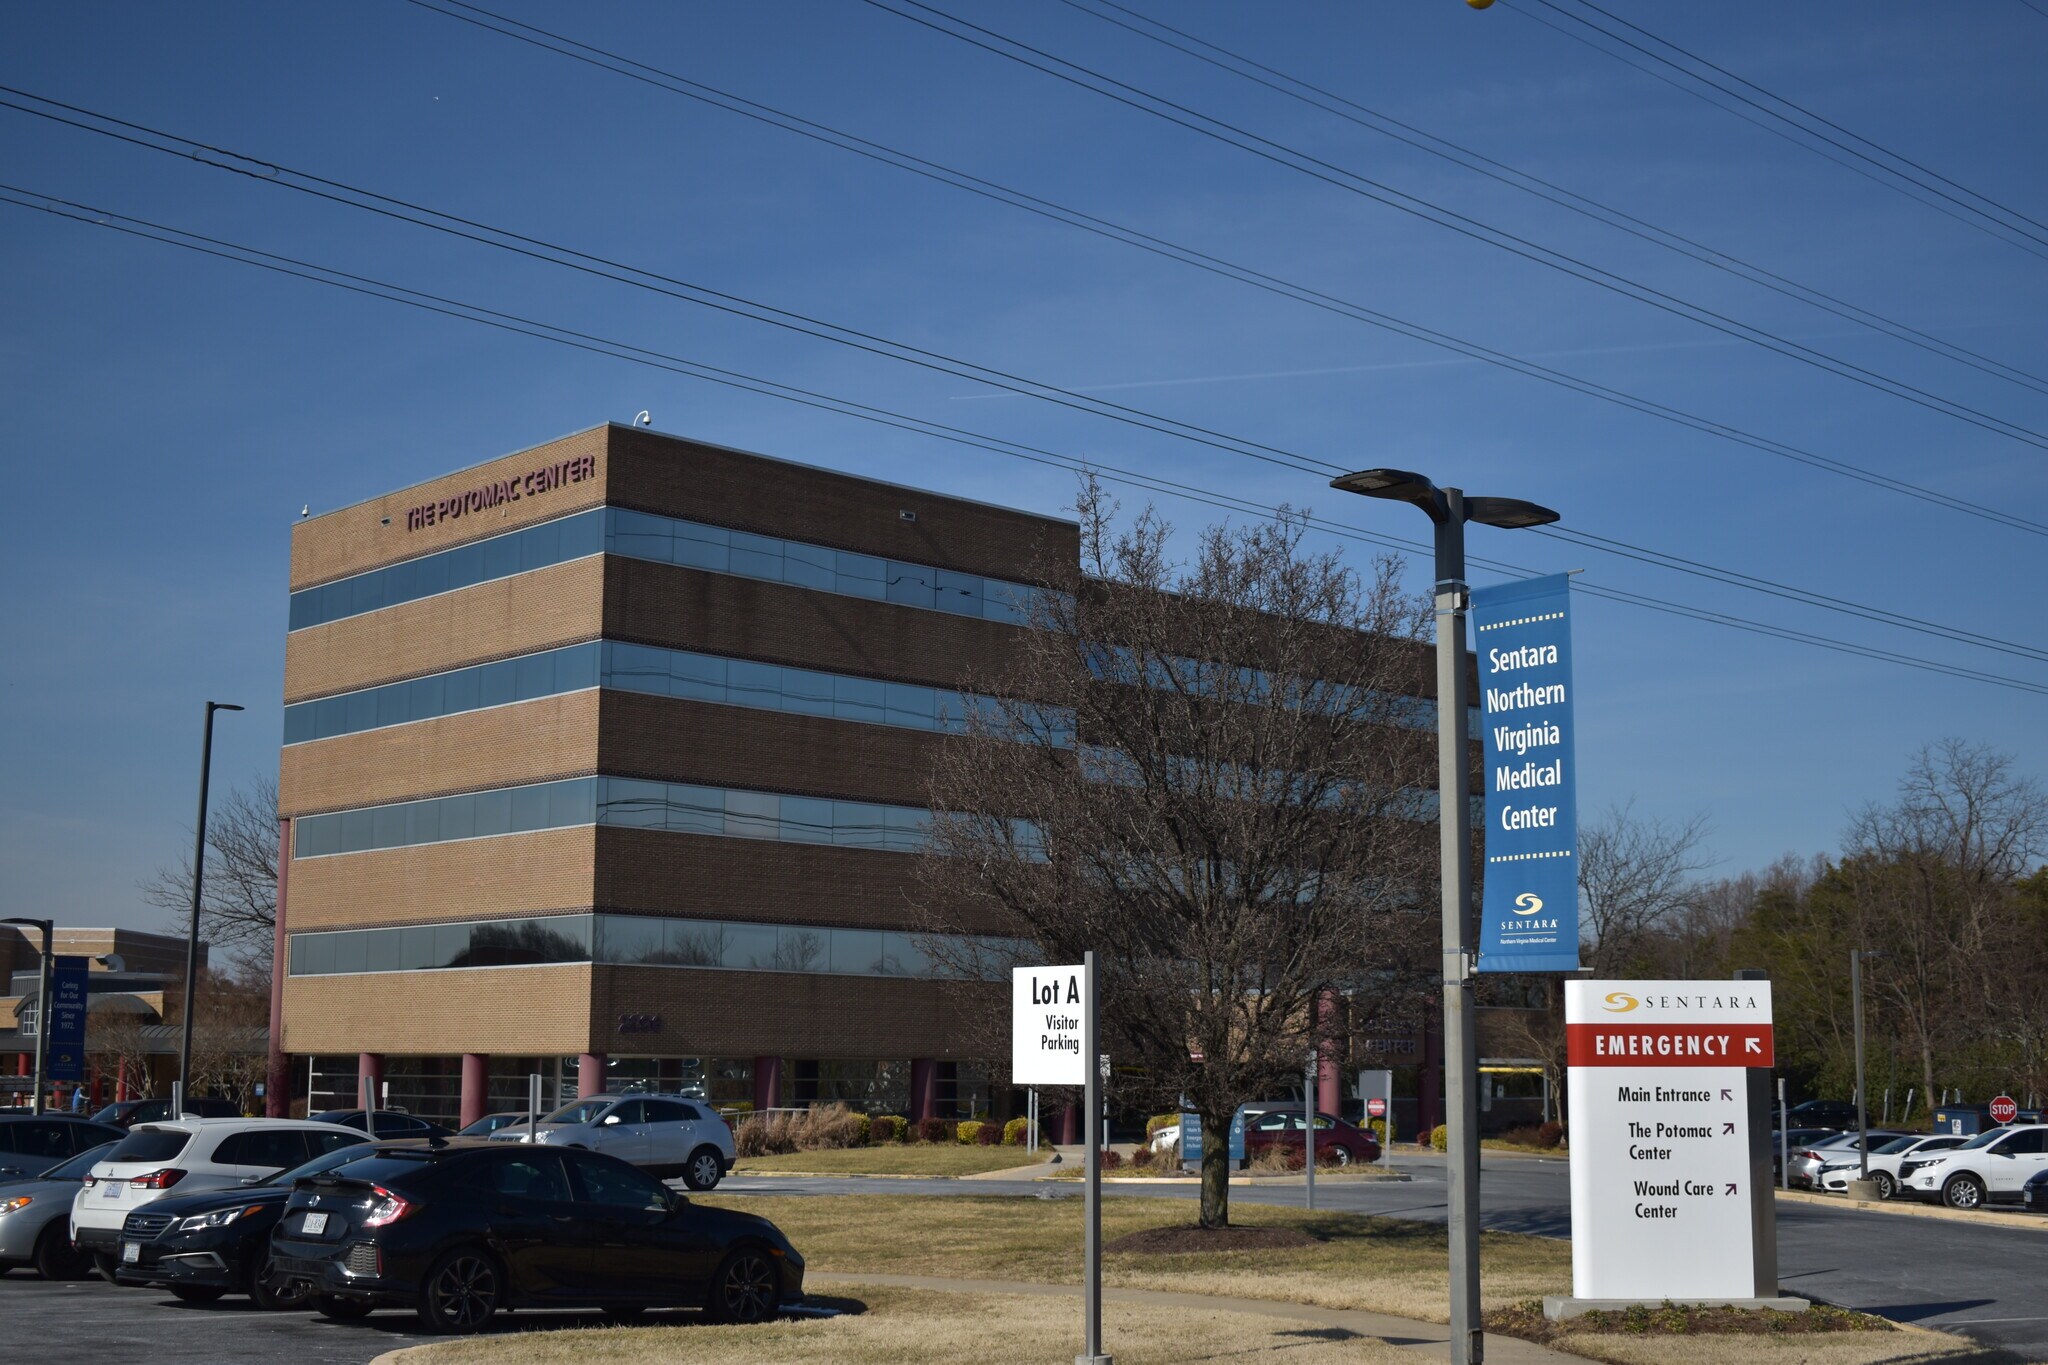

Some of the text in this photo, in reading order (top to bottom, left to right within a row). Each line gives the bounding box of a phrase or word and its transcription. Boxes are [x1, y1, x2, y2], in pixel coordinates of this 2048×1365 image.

[405, 454, 595, 532] THE POTOMAC CENTER
[1489, 644, 1558, 674] Sentara
[1487, 682, 1565, 714] Northern
[1494, 720, 1560, 755] Virginia
[1496, 758, 1561, 792] Medical
[1501, 805, 1557, 831] Center
[62, 981, 79, 990] Caring
[1032, 975, 1080, 1005] Lot A
[60, 991, 68, 999] for
[1646, 996, 1757, 1009] SENTARA
[54, 1001, 84, 1011] Community
[1046, 1015, 1079, 1030] Visitor
[1041, 1033, 1079, 1055] Parking
[1596, 1035, 1730, 1056] EMERGENCY
[1618, 1086, 1711, 1102] Main Entrance
[1991, 1105, 2015, 1114] STOP
[1628, 1122, 1712, 1138] The Potomac
[1629, 1144, 1672, 1160] Center
[1634, 1180, 1714, 1197] Wound Care
[1635, 1203, 1678, 1219] Center
